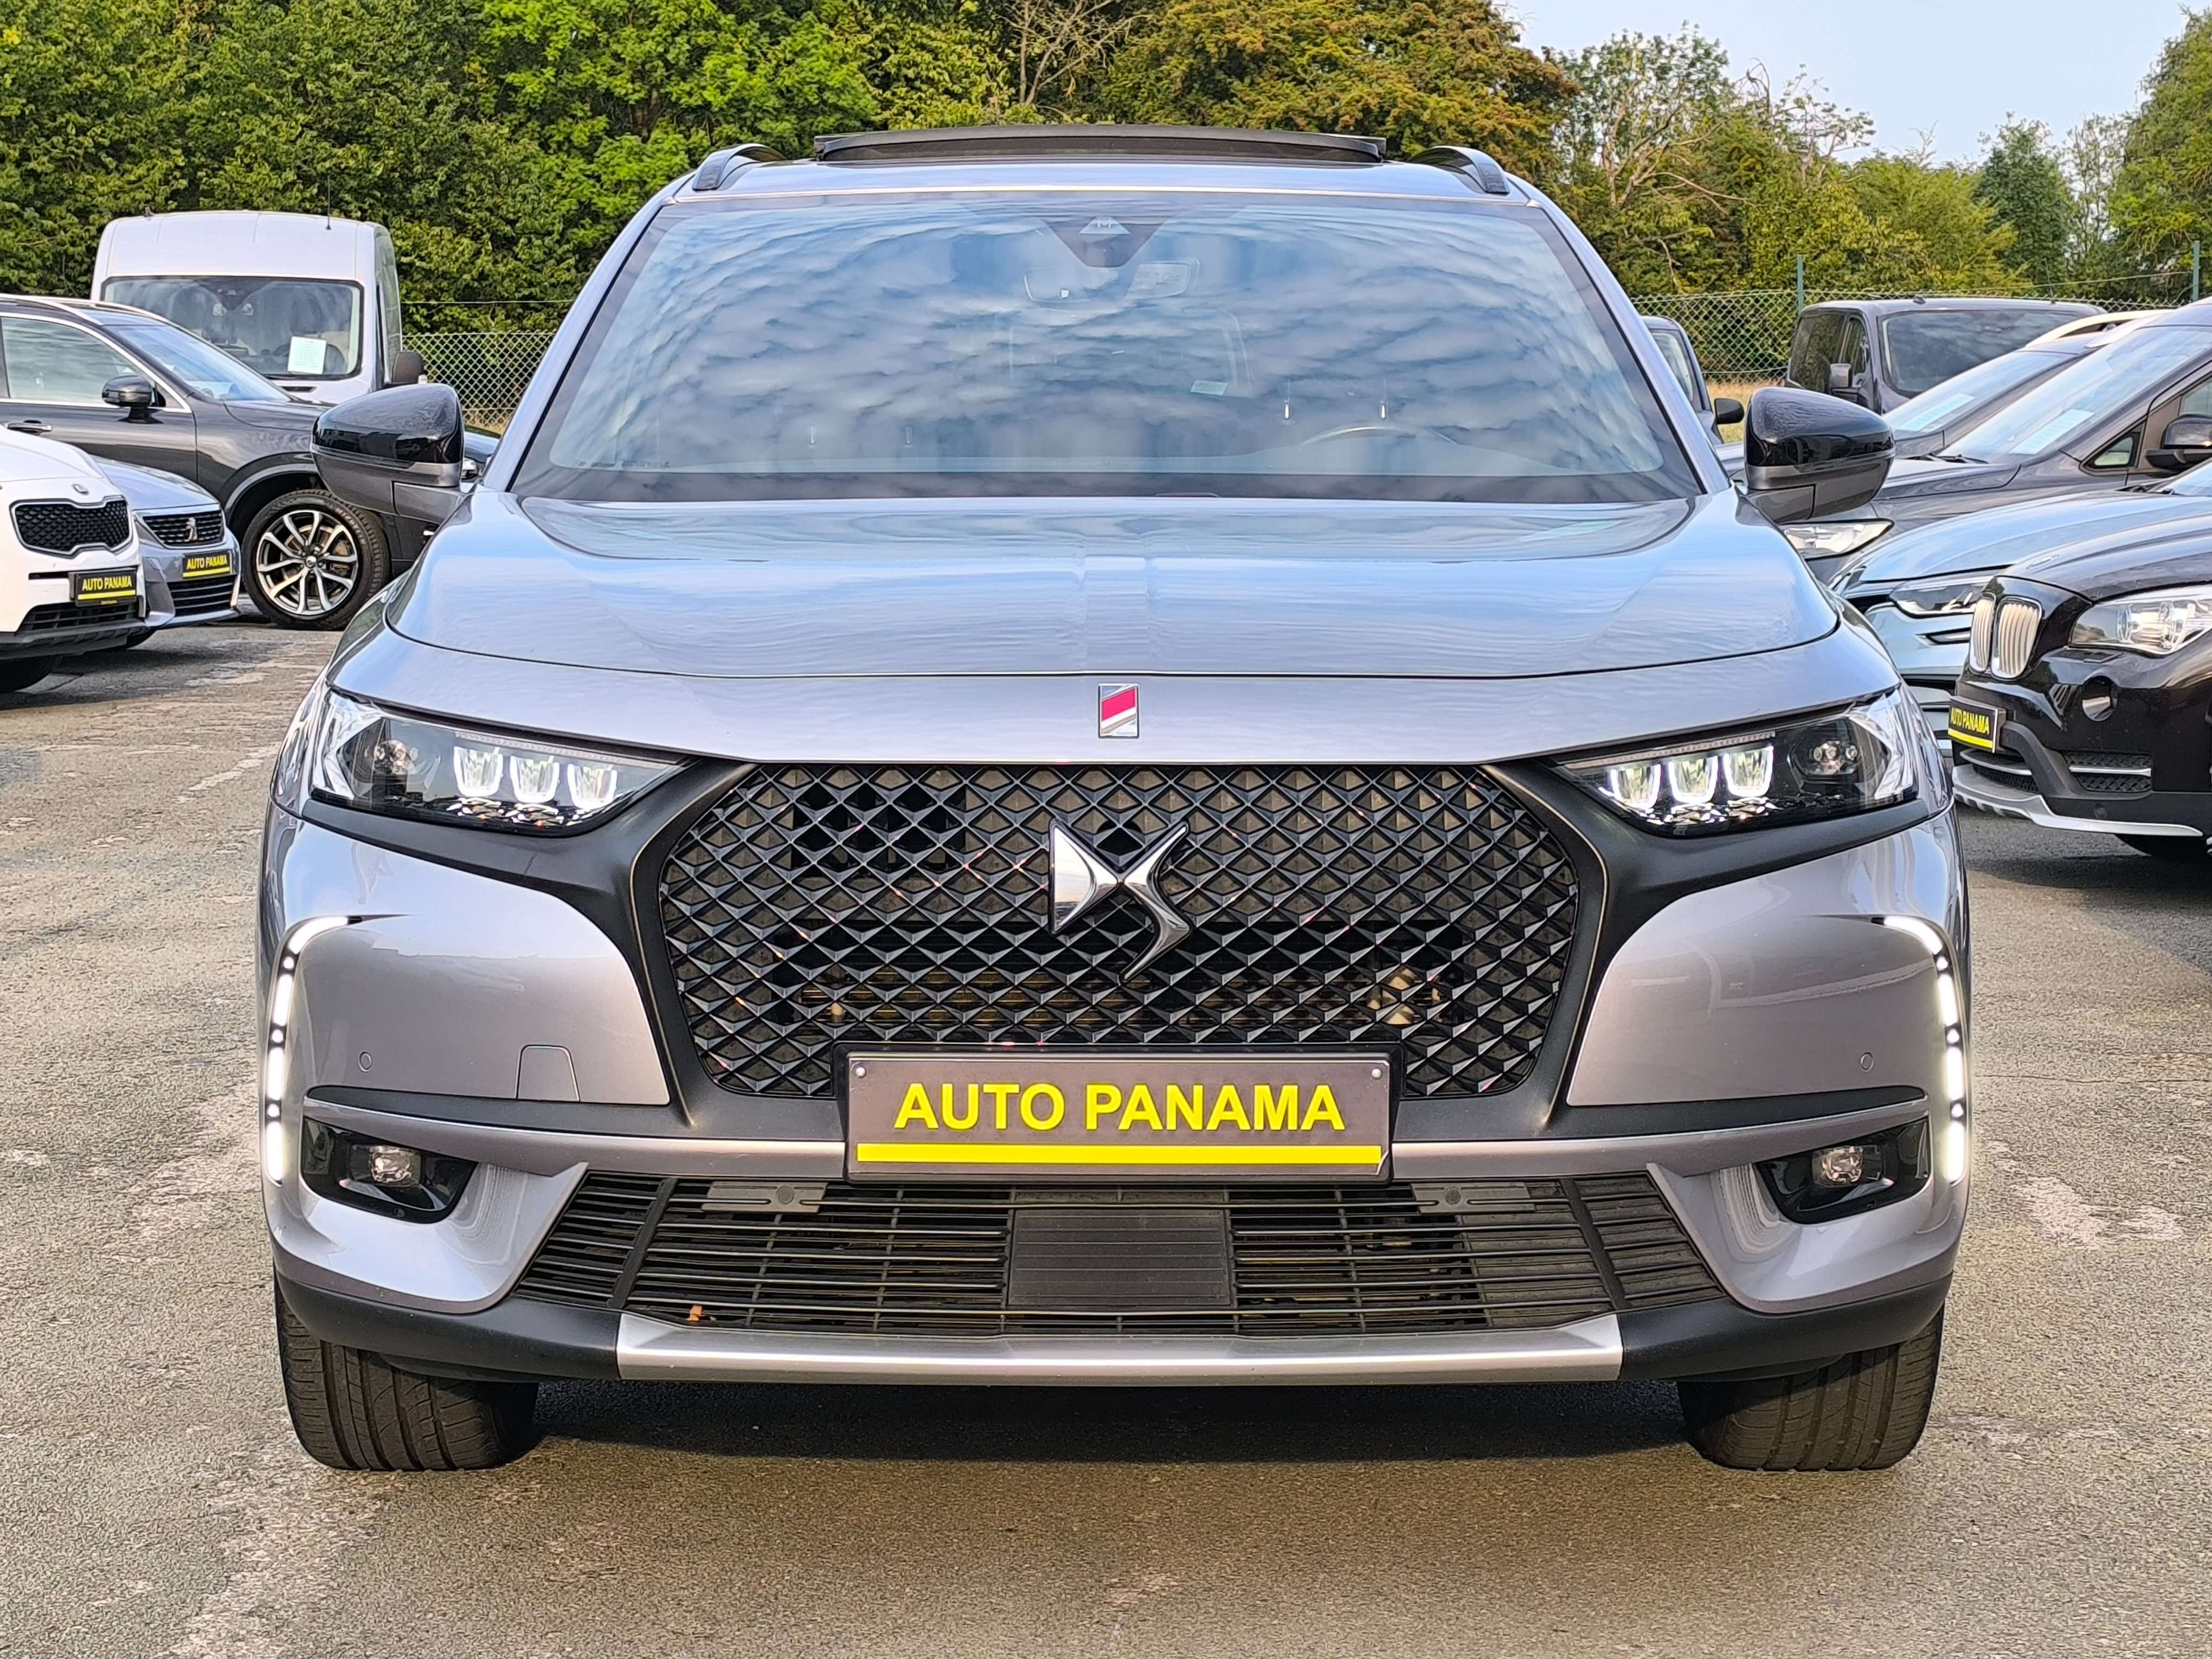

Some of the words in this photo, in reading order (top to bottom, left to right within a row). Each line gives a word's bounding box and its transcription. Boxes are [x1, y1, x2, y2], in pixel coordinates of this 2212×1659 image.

[187, 558, 205, 570] AUTO
[82, 578, 103, 591] AUTO
[104, 576, 132, 589] PANAMA
[1951, 707, 1962, 726] AUTO
[1963, 711, 1989, 735] PANAMA
[893, 1082, 1066, 1132] AUTO
[1084, 1082, 1345, 1132] PANAMA
